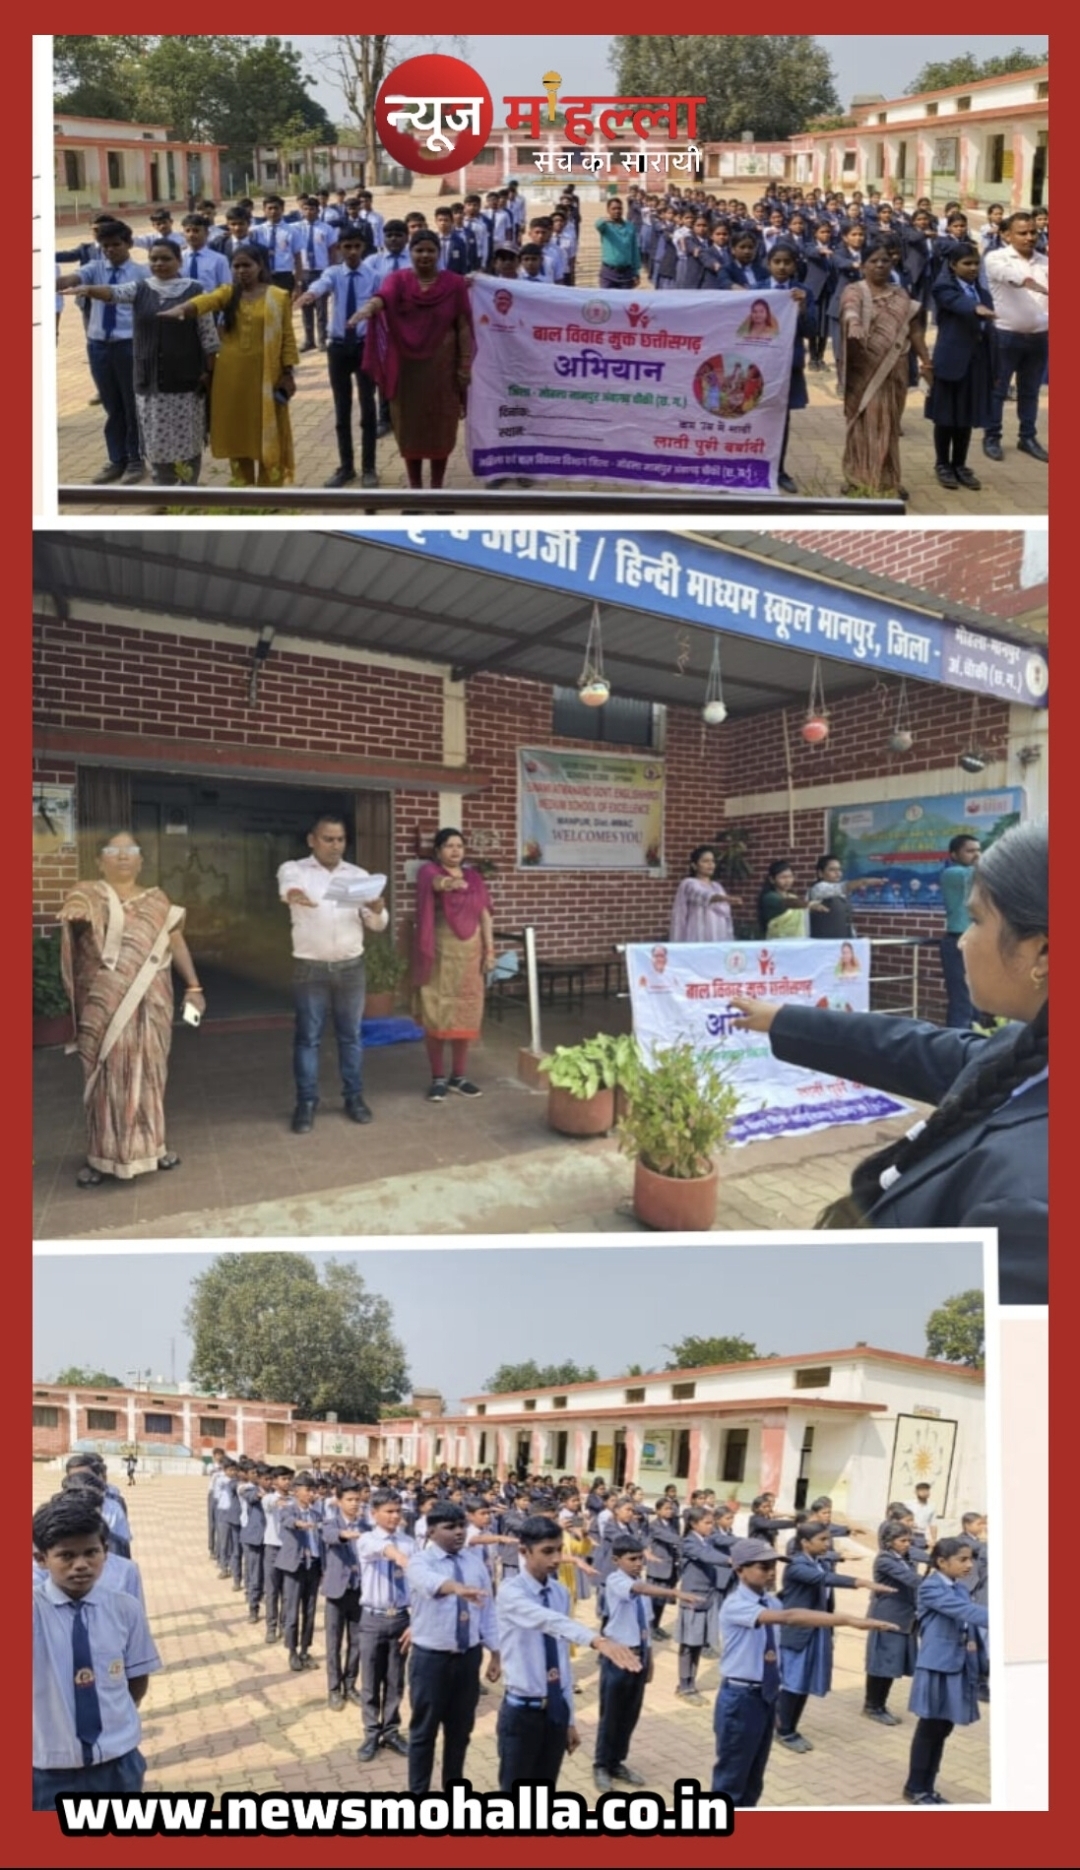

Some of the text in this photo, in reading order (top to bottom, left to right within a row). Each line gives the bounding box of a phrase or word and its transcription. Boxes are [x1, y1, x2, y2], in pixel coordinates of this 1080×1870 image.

[533, 326, 562, 342] बाल
[566, 324, 603, 344] विवाह
[608, 331, 636, 350] मुक्त
[641, 330, 703, 354] छत्तीसगढ़
[554, 348, 665, 382] अभियान
[616, 538, 680, 598] हिन्दी
[687, 570, 759, 619] माध्यम
[764, 592, 813, 640] स्कूल
[818, 607, 881, 658] मानपुर,
[888, 619, 931, 664] जिला
